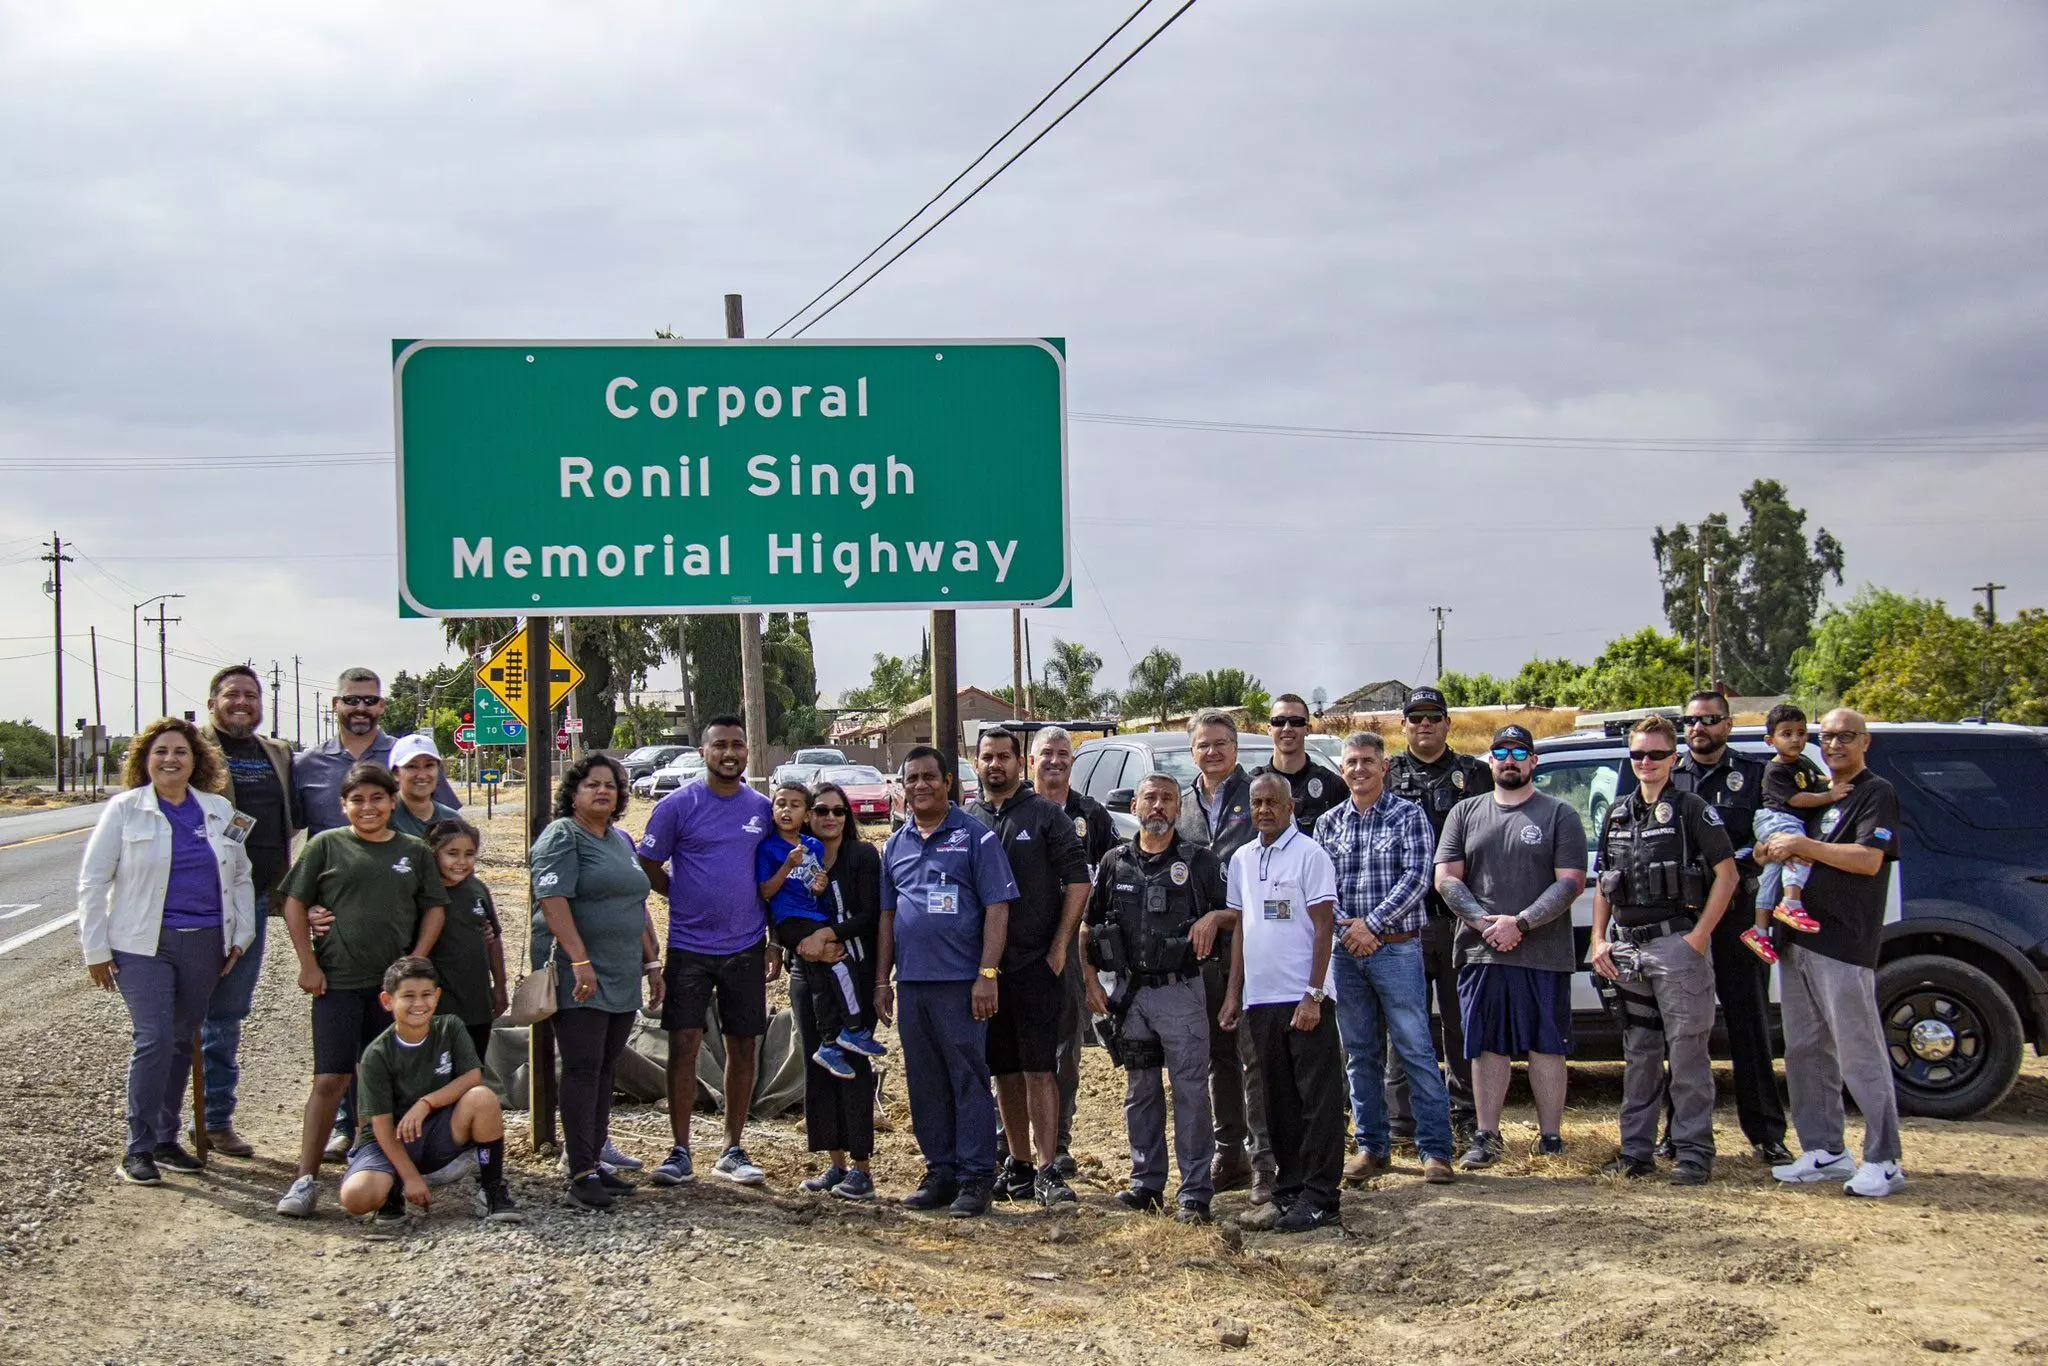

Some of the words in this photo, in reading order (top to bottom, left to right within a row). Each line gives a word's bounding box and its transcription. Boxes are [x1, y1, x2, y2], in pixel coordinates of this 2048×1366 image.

[605, 376, 868, 427] Corporal
[560, 455, 710, 498] Ronil
[747, 454, 914, 510] Singh
[453, 534, 730, 579] Memorial
[768, 532, 1018, 588] Highway
[1411, 692, 1437, 702] POLICE
[510, 726, 516, 735] 5
[557, 735, 569, 744] STOP
